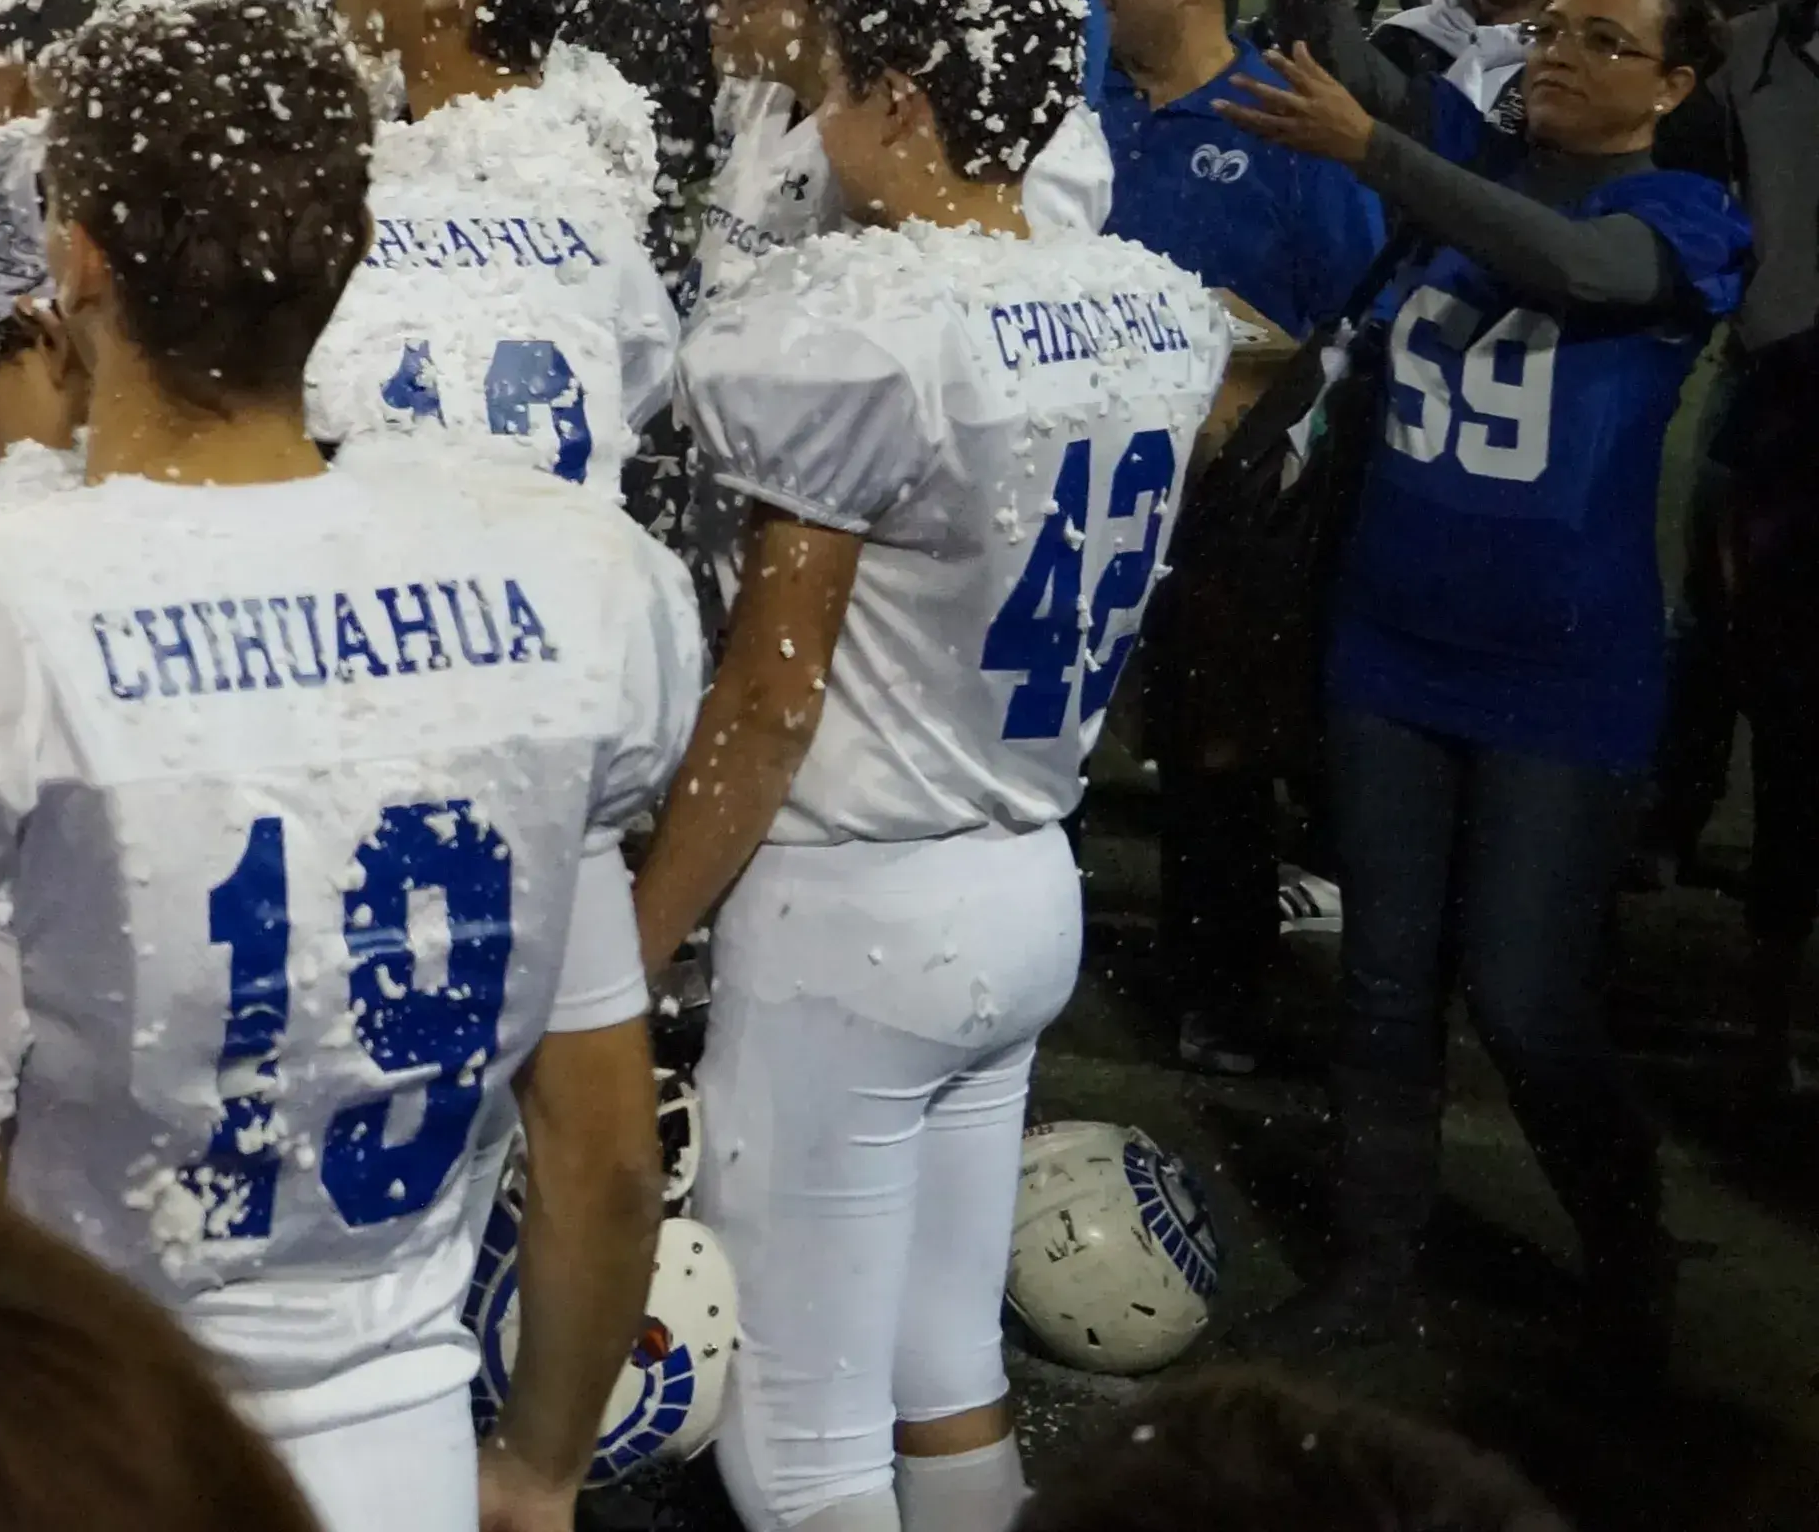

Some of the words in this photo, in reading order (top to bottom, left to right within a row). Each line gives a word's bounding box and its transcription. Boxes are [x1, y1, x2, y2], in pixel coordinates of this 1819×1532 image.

[1385, 285, 1561, 482] 59
[91, 578, 560, 702] CHIHUAHUA
[980, 428, 1177, 741] 42
